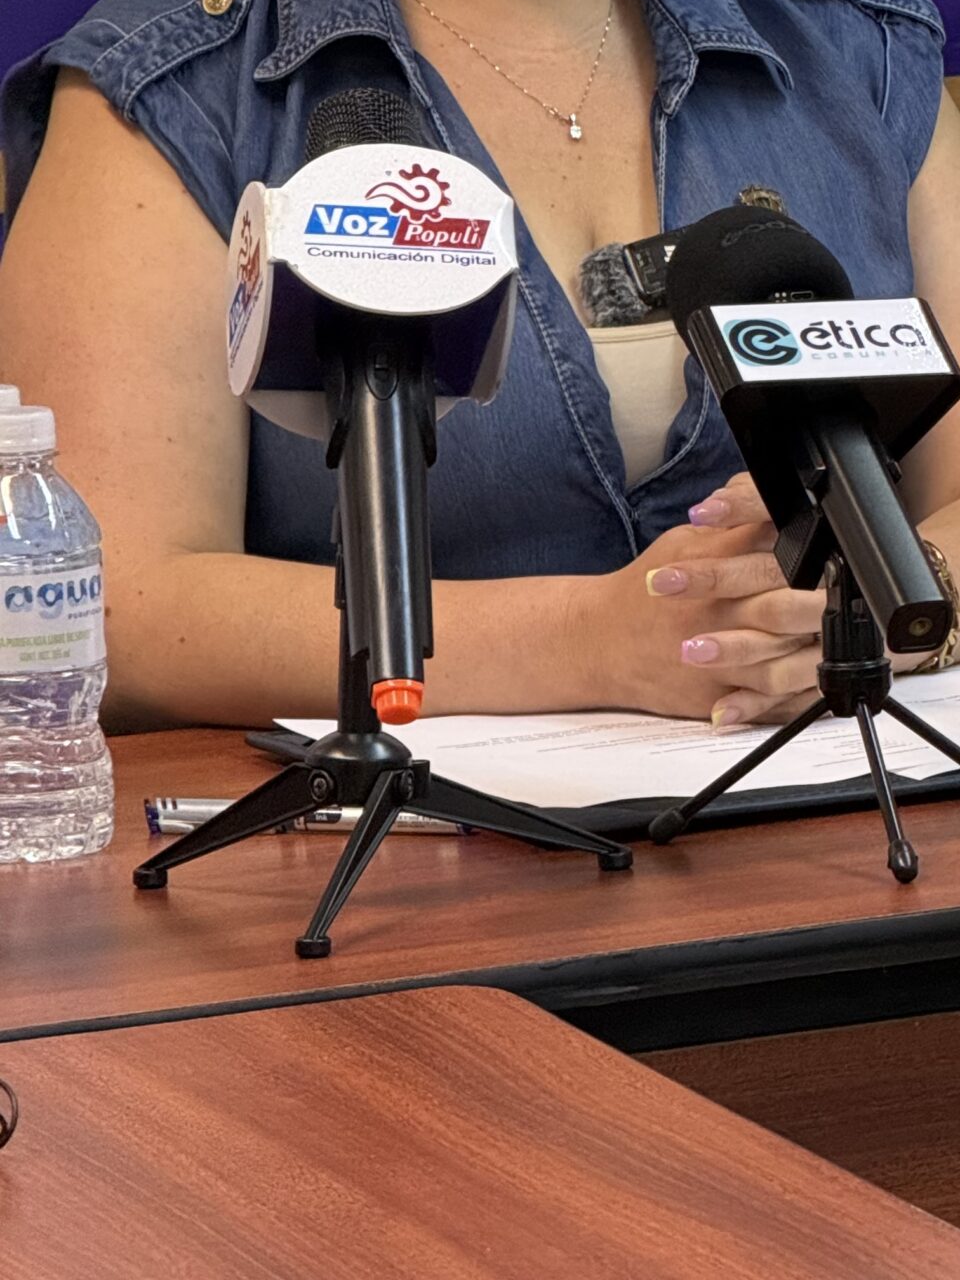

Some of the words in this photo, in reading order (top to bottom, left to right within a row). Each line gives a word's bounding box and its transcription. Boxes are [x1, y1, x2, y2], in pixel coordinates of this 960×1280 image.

[315, 206, 390, 237] Voz
[404, 224, 480, 247] Populi
[307, 246, 435, 264] Comunicación
[441, 253, 497, 267] Digital
[800, 319, 928, 350] ética
